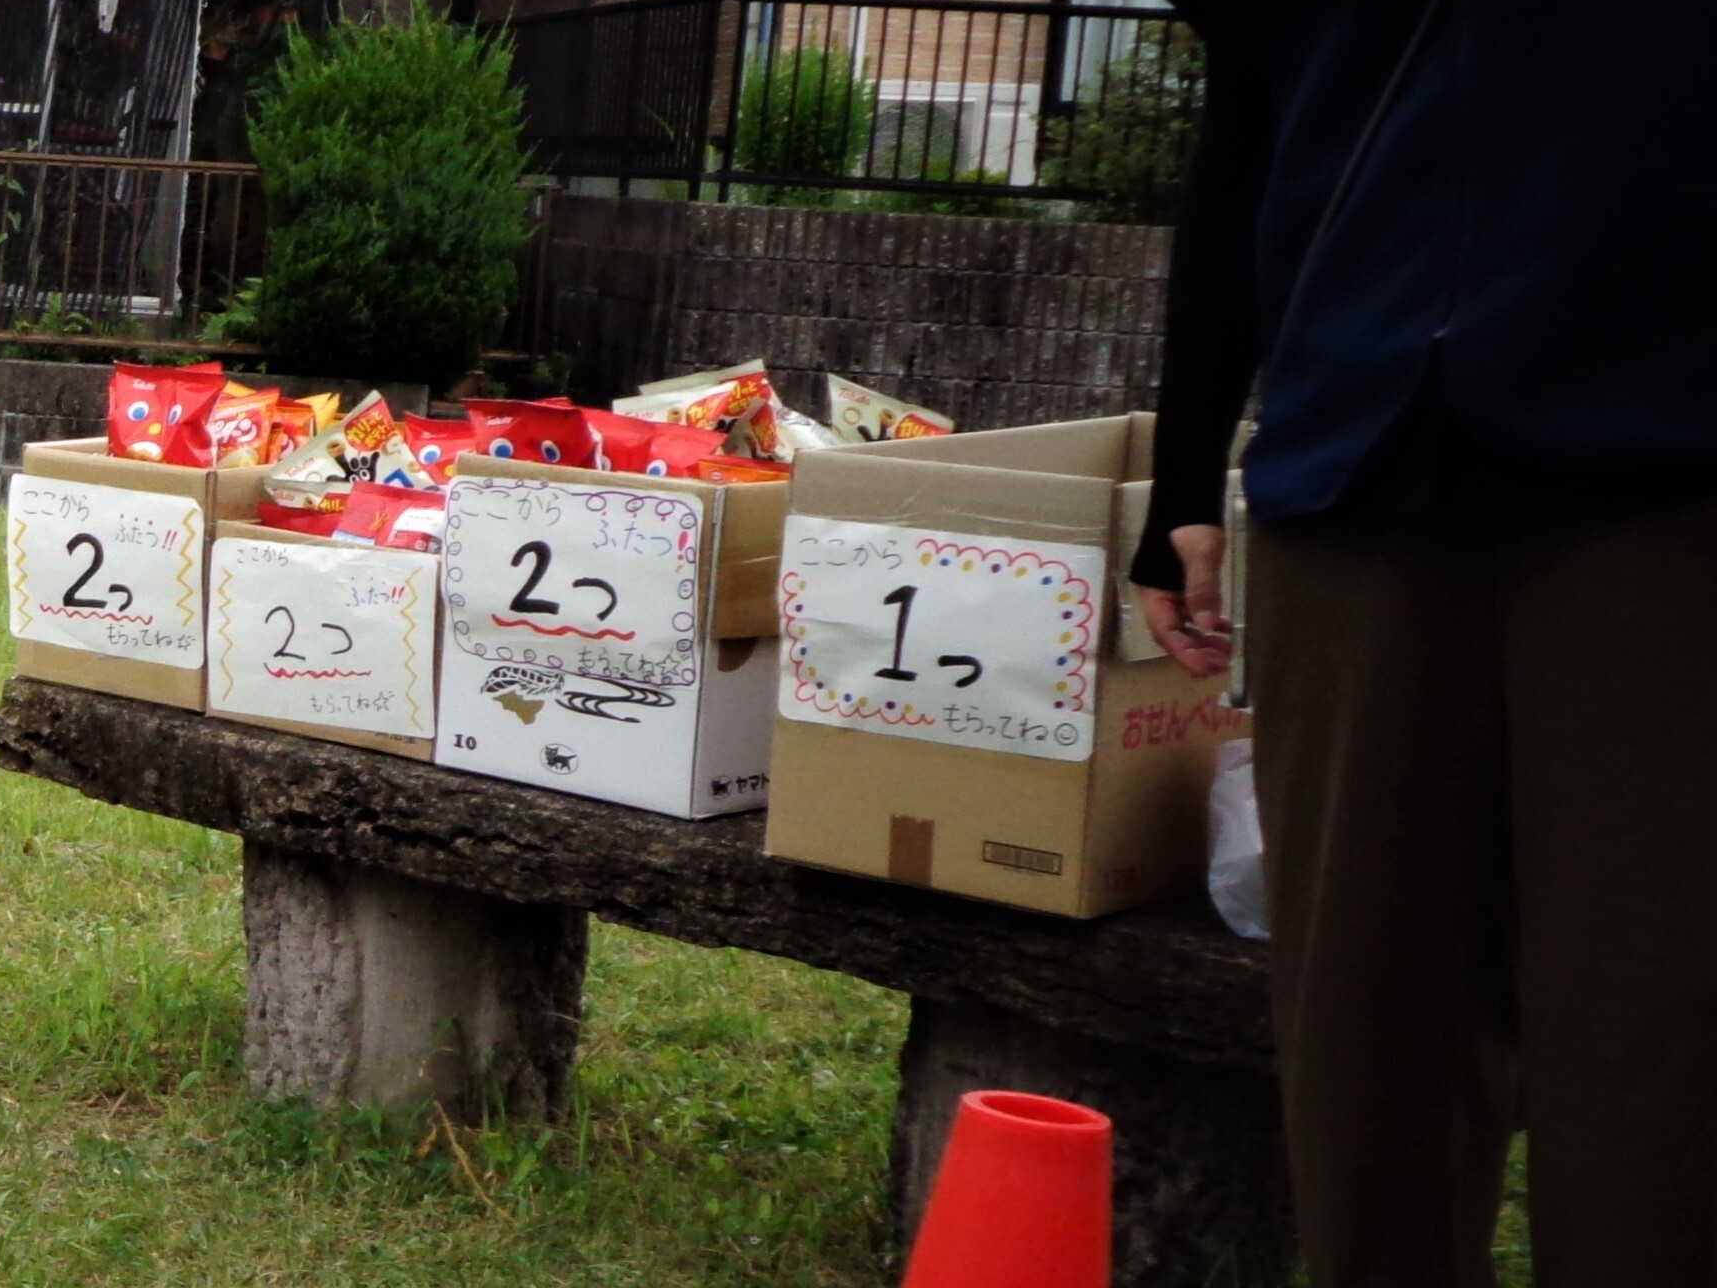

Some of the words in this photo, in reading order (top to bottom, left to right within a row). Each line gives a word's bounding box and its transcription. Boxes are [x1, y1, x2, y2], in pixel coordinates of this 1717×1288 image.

[23, 490, 90, 522] ここから
[459, 487, 562, 527] ここから
[237, 546, 289, 566] ここから
[799, 537, 903, 570] ここから
[453, 733, 478, 751] 10
